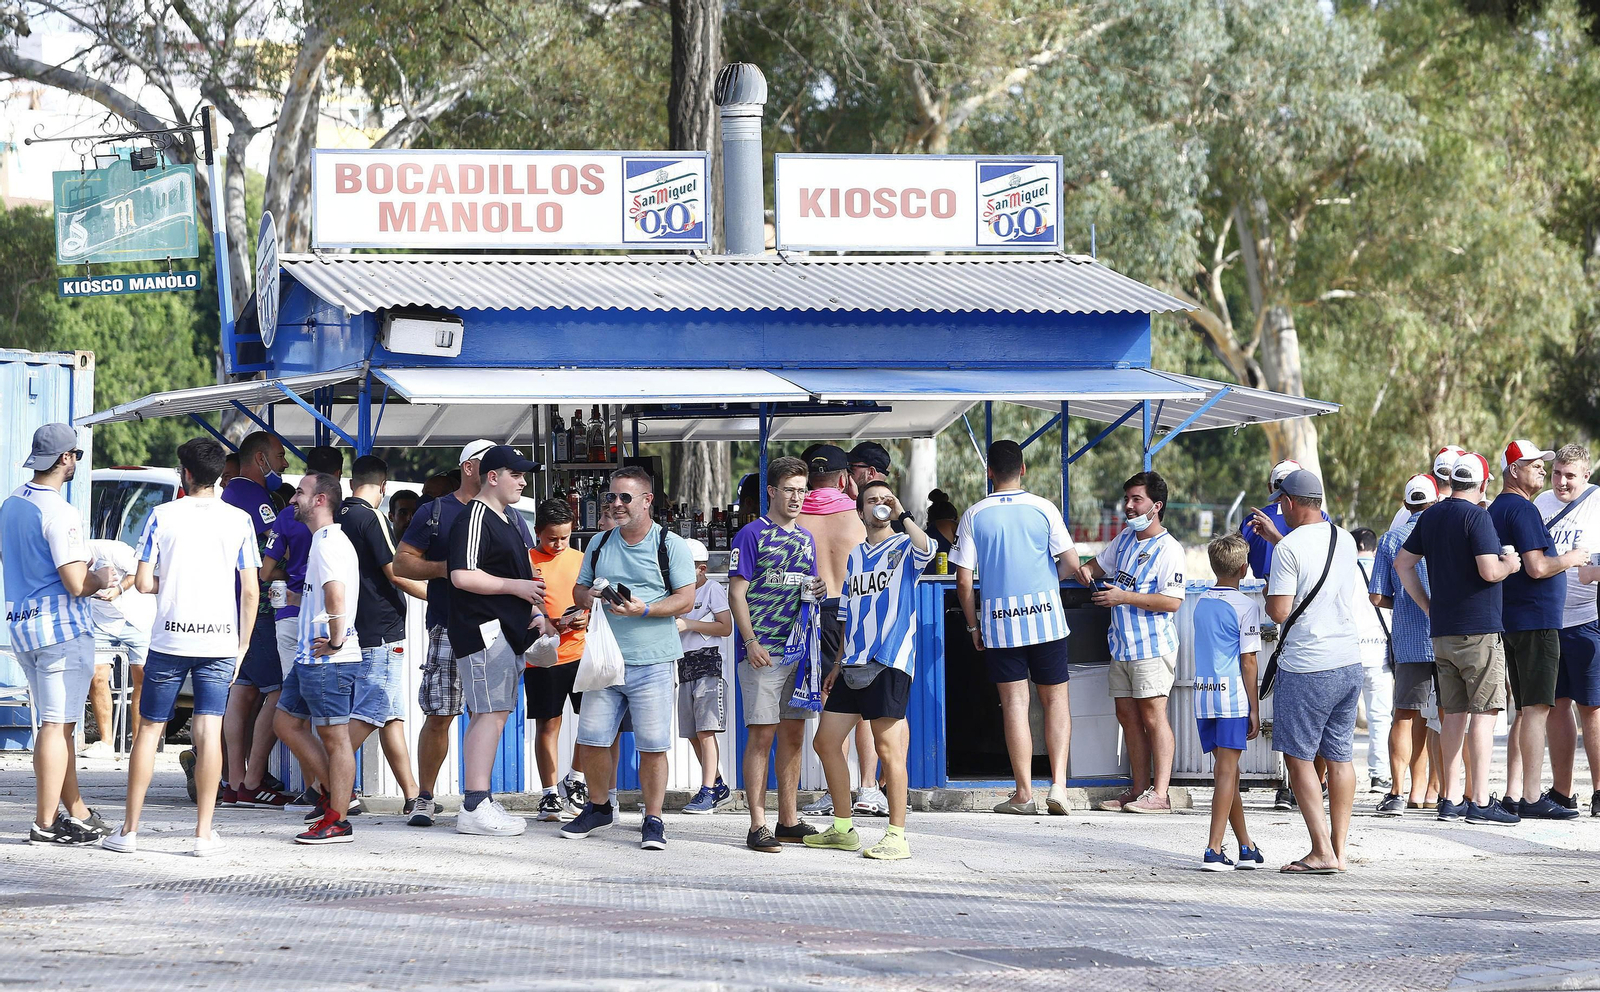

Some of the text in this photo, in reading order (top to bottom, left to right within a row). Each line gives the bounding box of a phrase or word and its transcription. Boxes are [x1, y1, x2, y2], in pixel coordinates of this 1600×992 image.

[335, 163, 605, 195] BOCADILLOS
[651, 179, 696, 205] Miguel
[799, 187, 957, 219] KIOSCO
[1004, 183, 1048, 208] Miguel
[379, 201, 563, 233] MANOLO
[63, 274, 197, 295] KIOSCO MANOLO
[992, 602, 1052, 620] BENAHAVIS
[164, 620, 231, 634] BENAHAVIS
